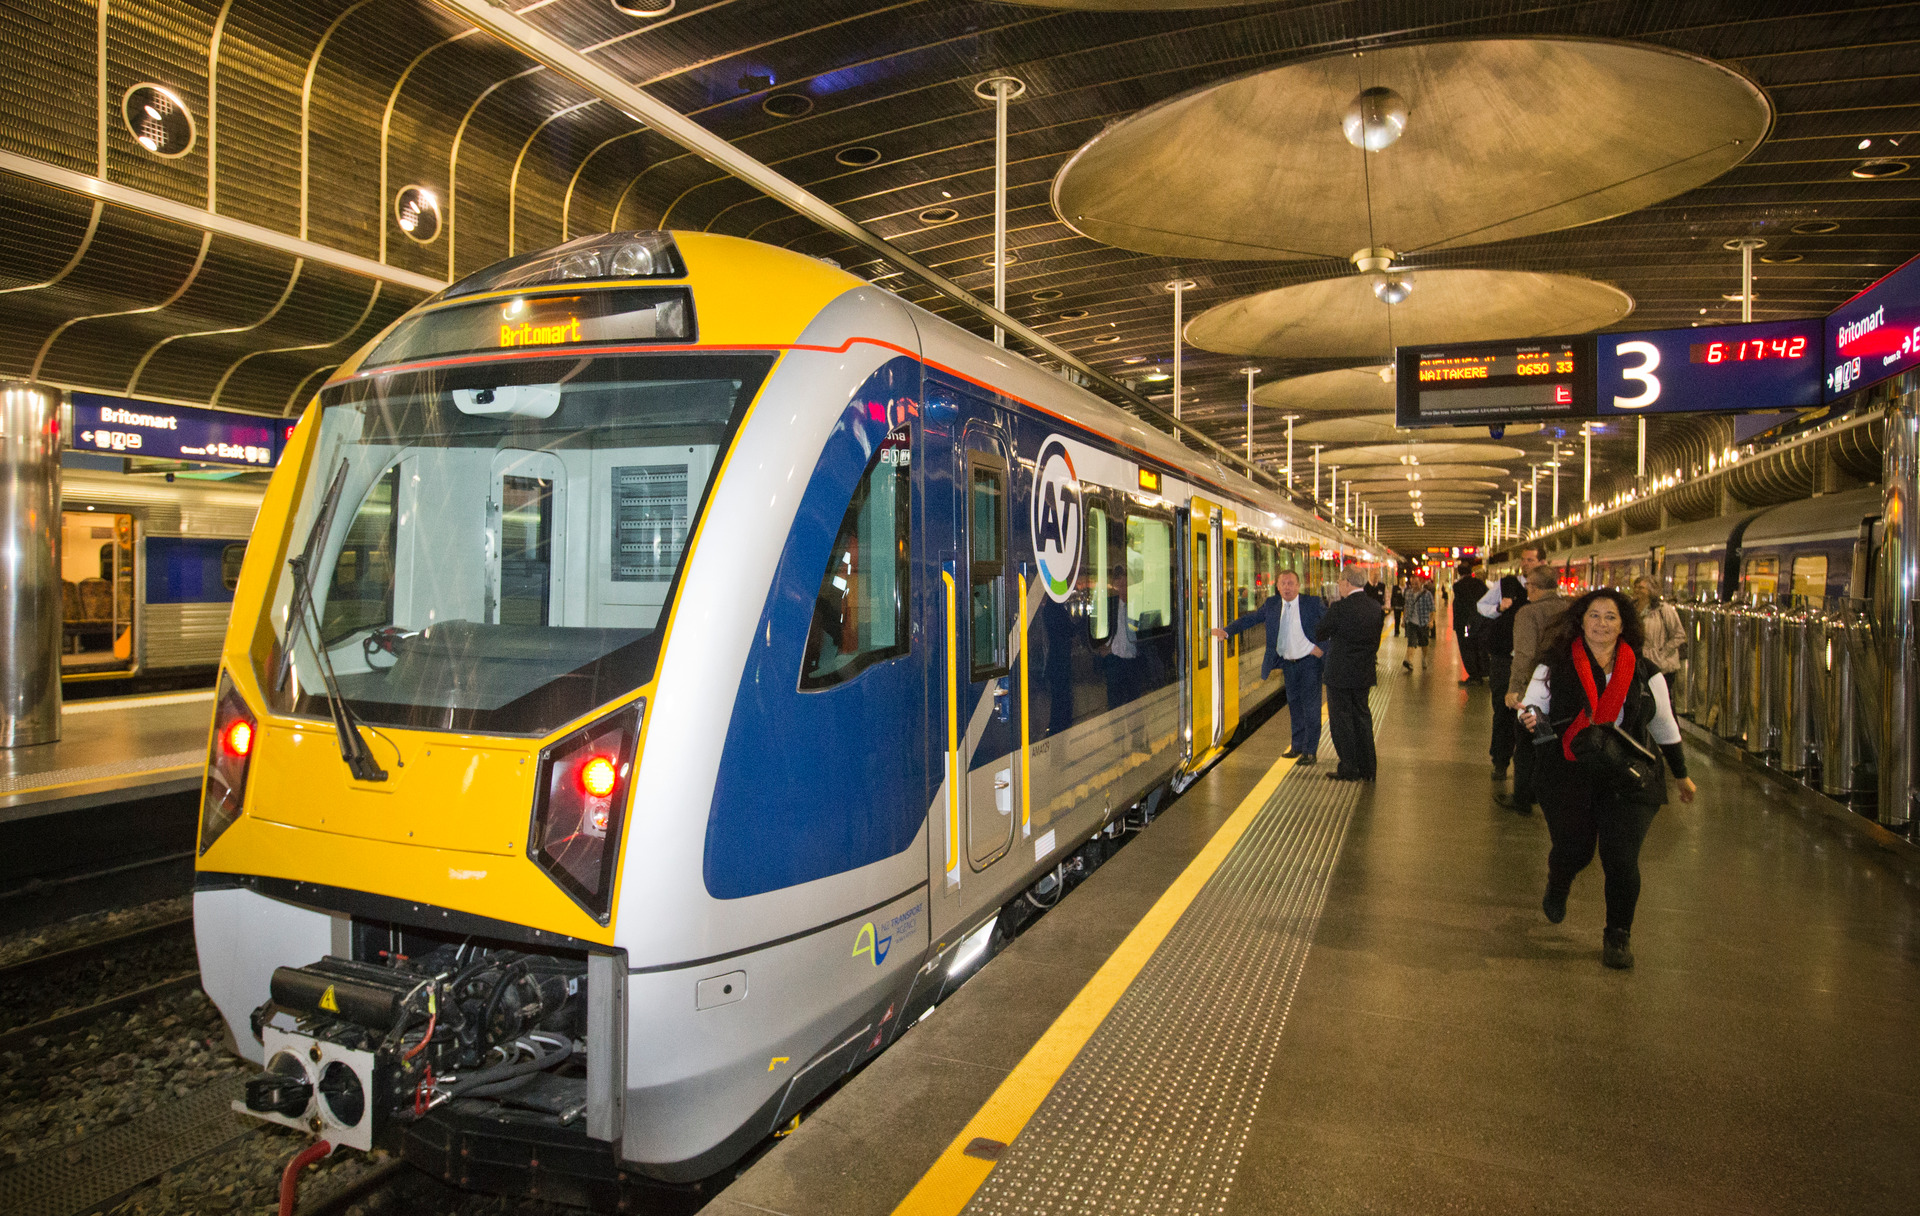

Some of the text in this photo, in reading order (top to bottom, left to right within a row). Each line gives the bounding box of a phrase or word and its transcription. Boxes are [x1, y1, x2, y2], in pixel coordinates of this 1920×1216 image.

[500, 317, 581, 348] Britomart
[1838, 304, 1885, 349] Britomart
[1419, 361, 1574, 382] WAITAKERE 0650 33
[1613, 340, 1662, 409] 3
[101, 406, 178, 431] Britomart
[218, 442, 245, 459] Exit
[1037, 480, 1077, 554] AT
[891, 902, 923, 927] TRANSPORT
